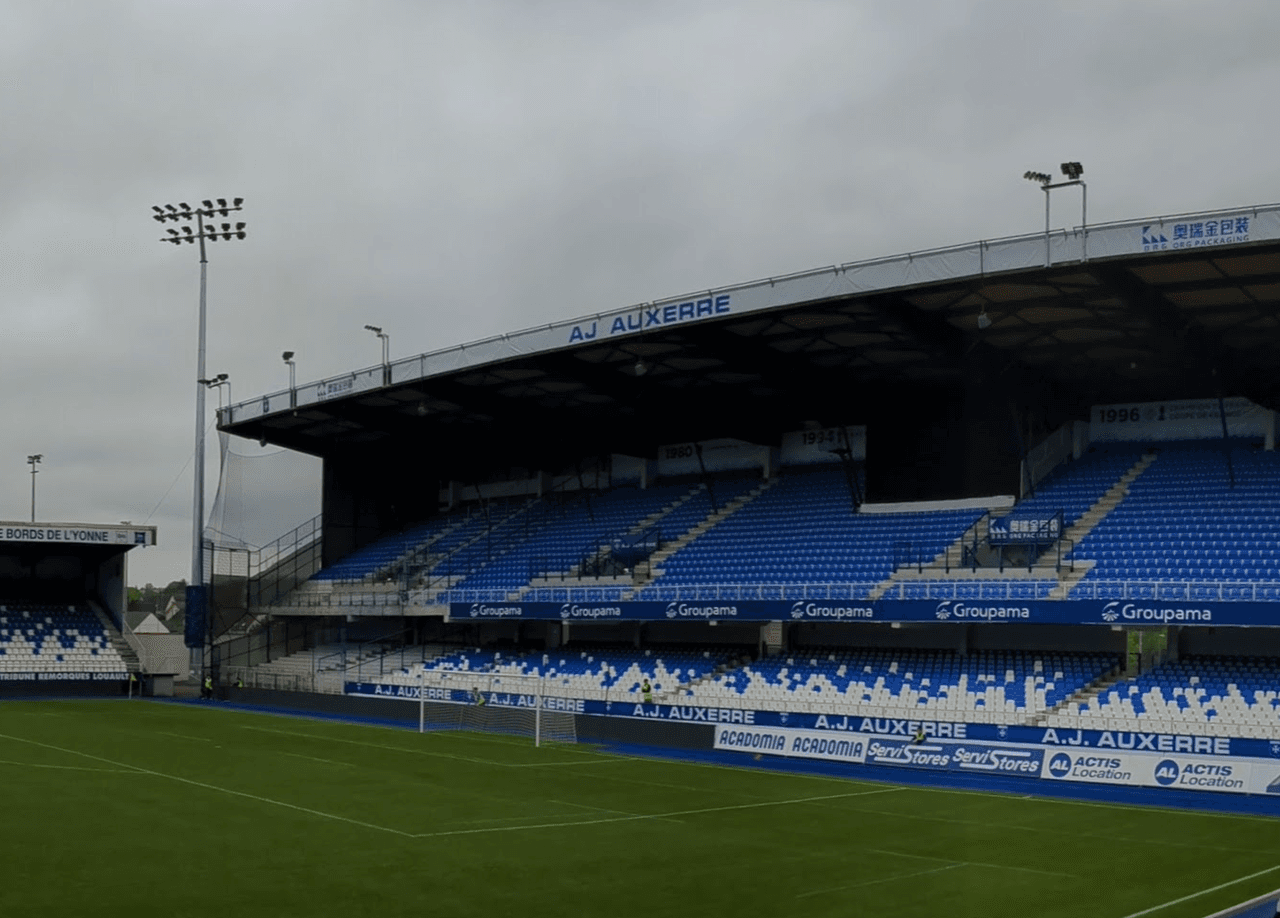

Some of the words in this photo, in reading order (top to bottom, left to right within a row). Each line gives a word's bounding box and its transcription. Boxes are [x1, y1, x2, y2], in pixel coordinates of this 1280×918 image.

[1173, 241, 1192, 249] ORG
[1195, 234, 1250, 246] PACKAGING
[569, 321, 597, 342] AJ
[610, 295, 730, 334] AUXERRE
[6, 529, 44, 539] BORDS
[47, 530, 61, 540] DE
[63, 530, 109, 542] L'YONNE
[479, 605, 523, 617] Groupama
[571, 605, 621, 618] Groupama
[678, 604, 737, 618] Groupama
[806, 604, 873, 619] Groupama
[953, 603, 1029, 620] Groupama
[1122, 604, 1211, 623] Groupama
[375, 684, 395, 696] A.J.
[397, 687, 451, 700] AUXERRE
[489, 693, 516, 705] A.J.
[517, 695, 585, 712] AUXERRE
[633, 704, 665, 718] A.J.
[669, 707, 755, 724] AUXERRE
[815, 715, 853, 730] A.J.
[859, 718, 967, 738] AUXERRE
[720, 730, 785, 750] ACADOMIA
[793, 732, 863, 756] ACADOMIA
[1042, 728, 1089, 745] A.J.
[1097, 732, 1231, 754] AUXERRE
[867, 742, 949, 767] ServiStores
[953, 748, 1039, 773] ServiStores
[1076, 756, 1121, 768] ACTIS
[1049, 760, 1071, 770] AL
[1155, 767, 1177, 778] AL
[1182, 763, 1232, 776] ACTIS
[1072, 767, 1131, 781] Location
[1180, 774, 1244, 789] Location
